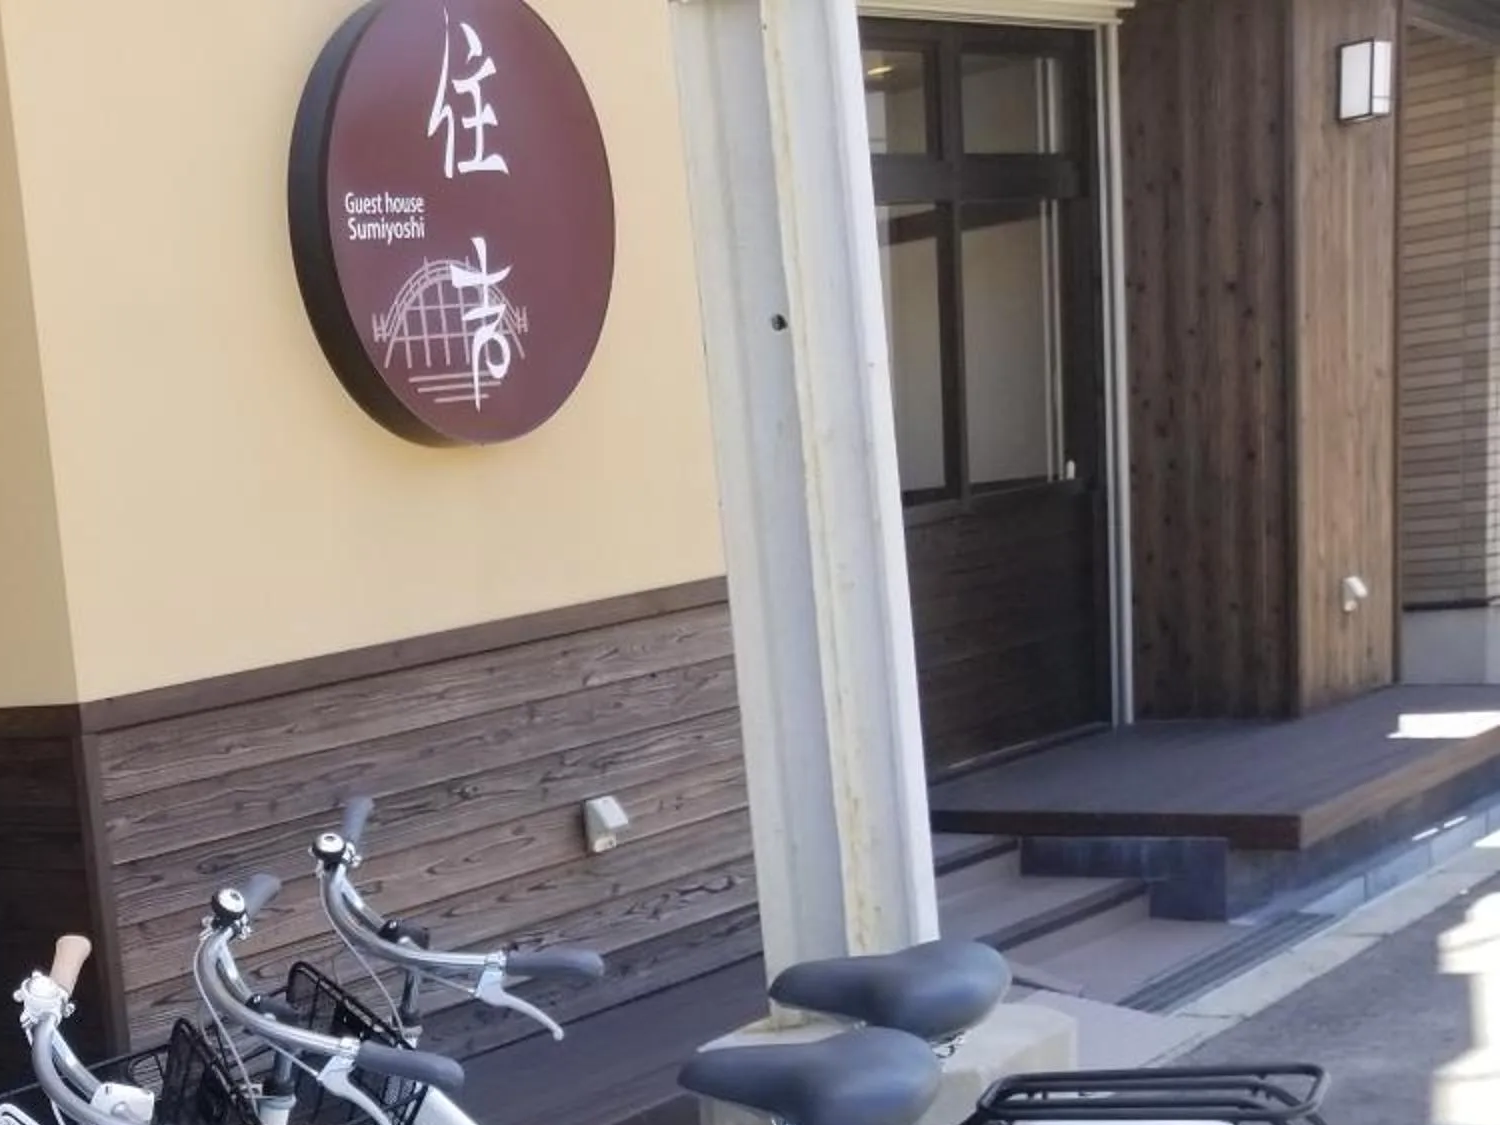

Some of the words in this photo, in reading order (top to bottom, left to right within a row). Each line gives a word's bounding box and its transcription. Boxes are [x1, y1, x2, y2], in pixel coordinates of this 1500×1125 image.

[345, 191, 383, 214] Guest
[385, 191, 425, 213] house
[427, 6, 514, 412] 住吉
[347, 215, 425, 246] Sumiyoshi
